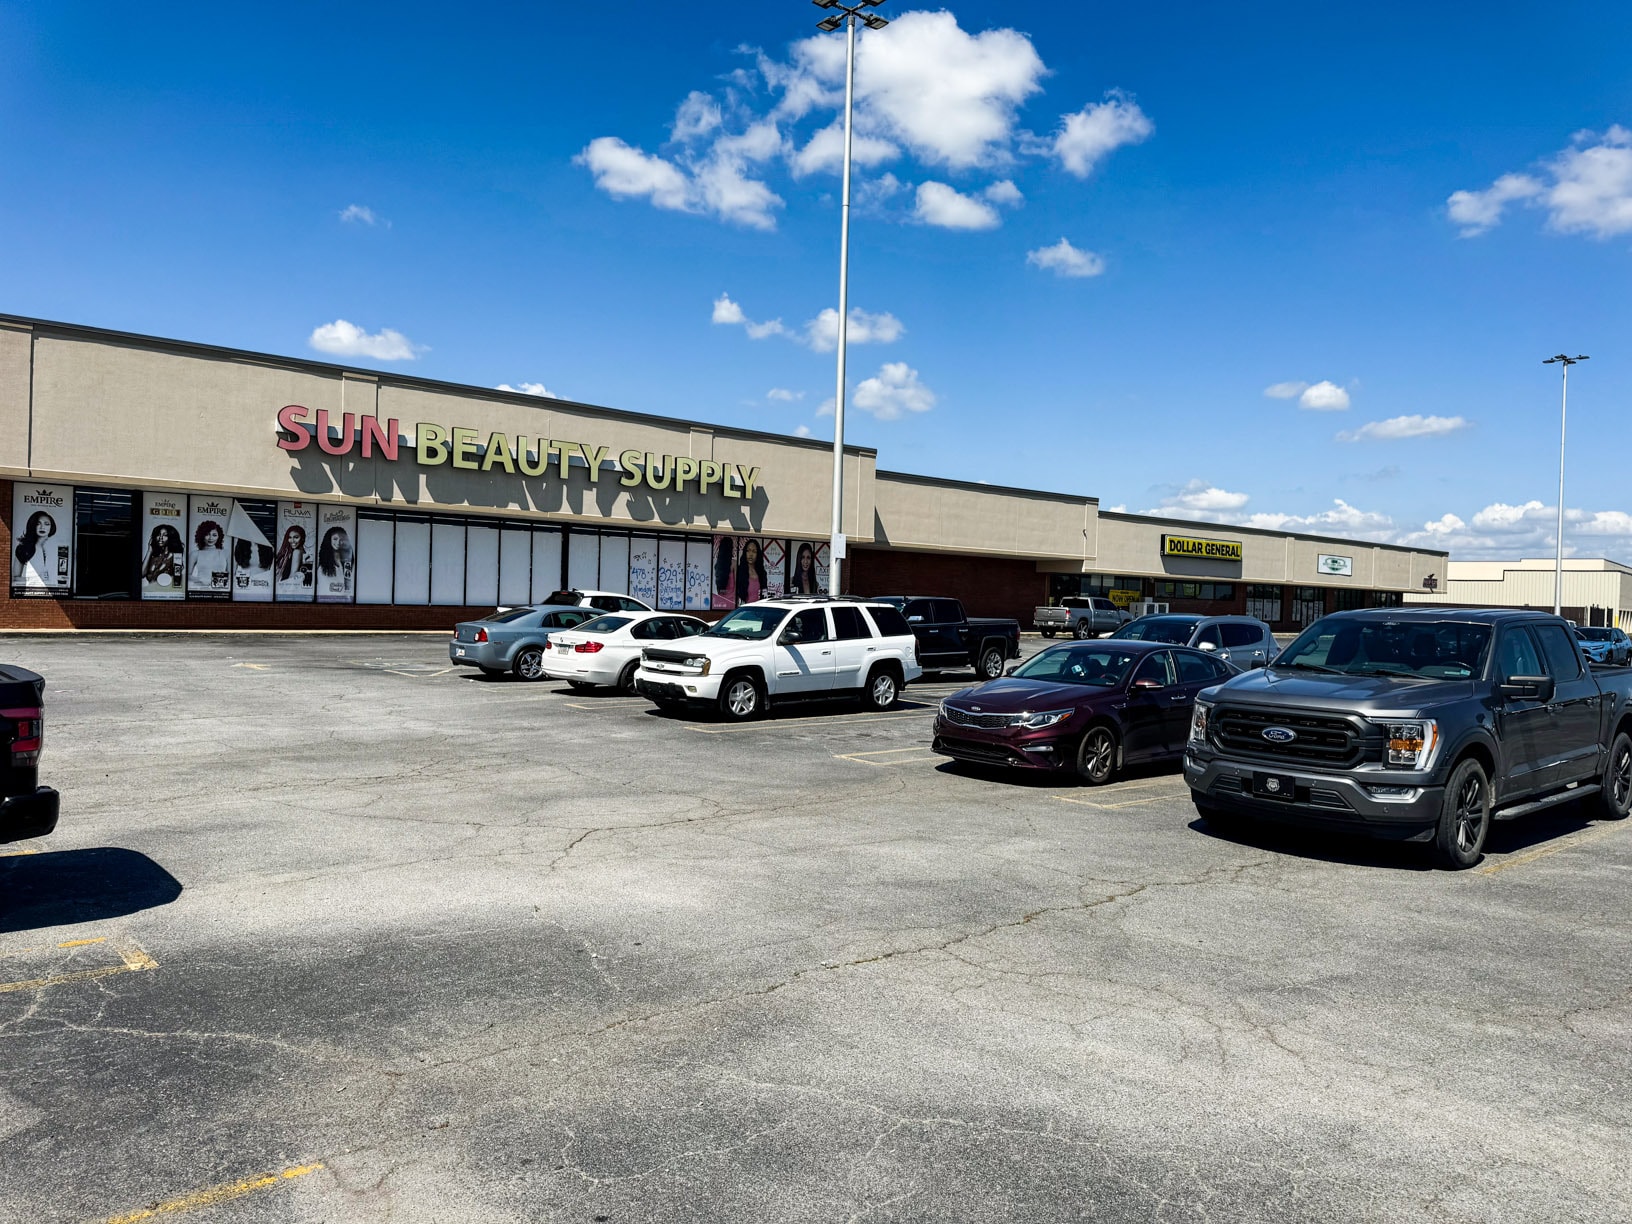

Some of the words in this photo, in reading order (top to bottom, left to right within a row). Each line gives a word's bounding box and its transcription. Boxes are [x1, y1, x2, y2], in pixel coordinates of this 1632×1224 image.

[277, 404, 400, 461] SUN
[416, 422, 610, 482] BEAUTY
[619, 449, 762, 500] SUPPLY
[24, 495, 64, 508] EMPIRE
[1169, 539, 1203, 554] DOLLAR
[1205, 543, 1240, 557] GENERAL
[658, 567, 678, 583] 329
